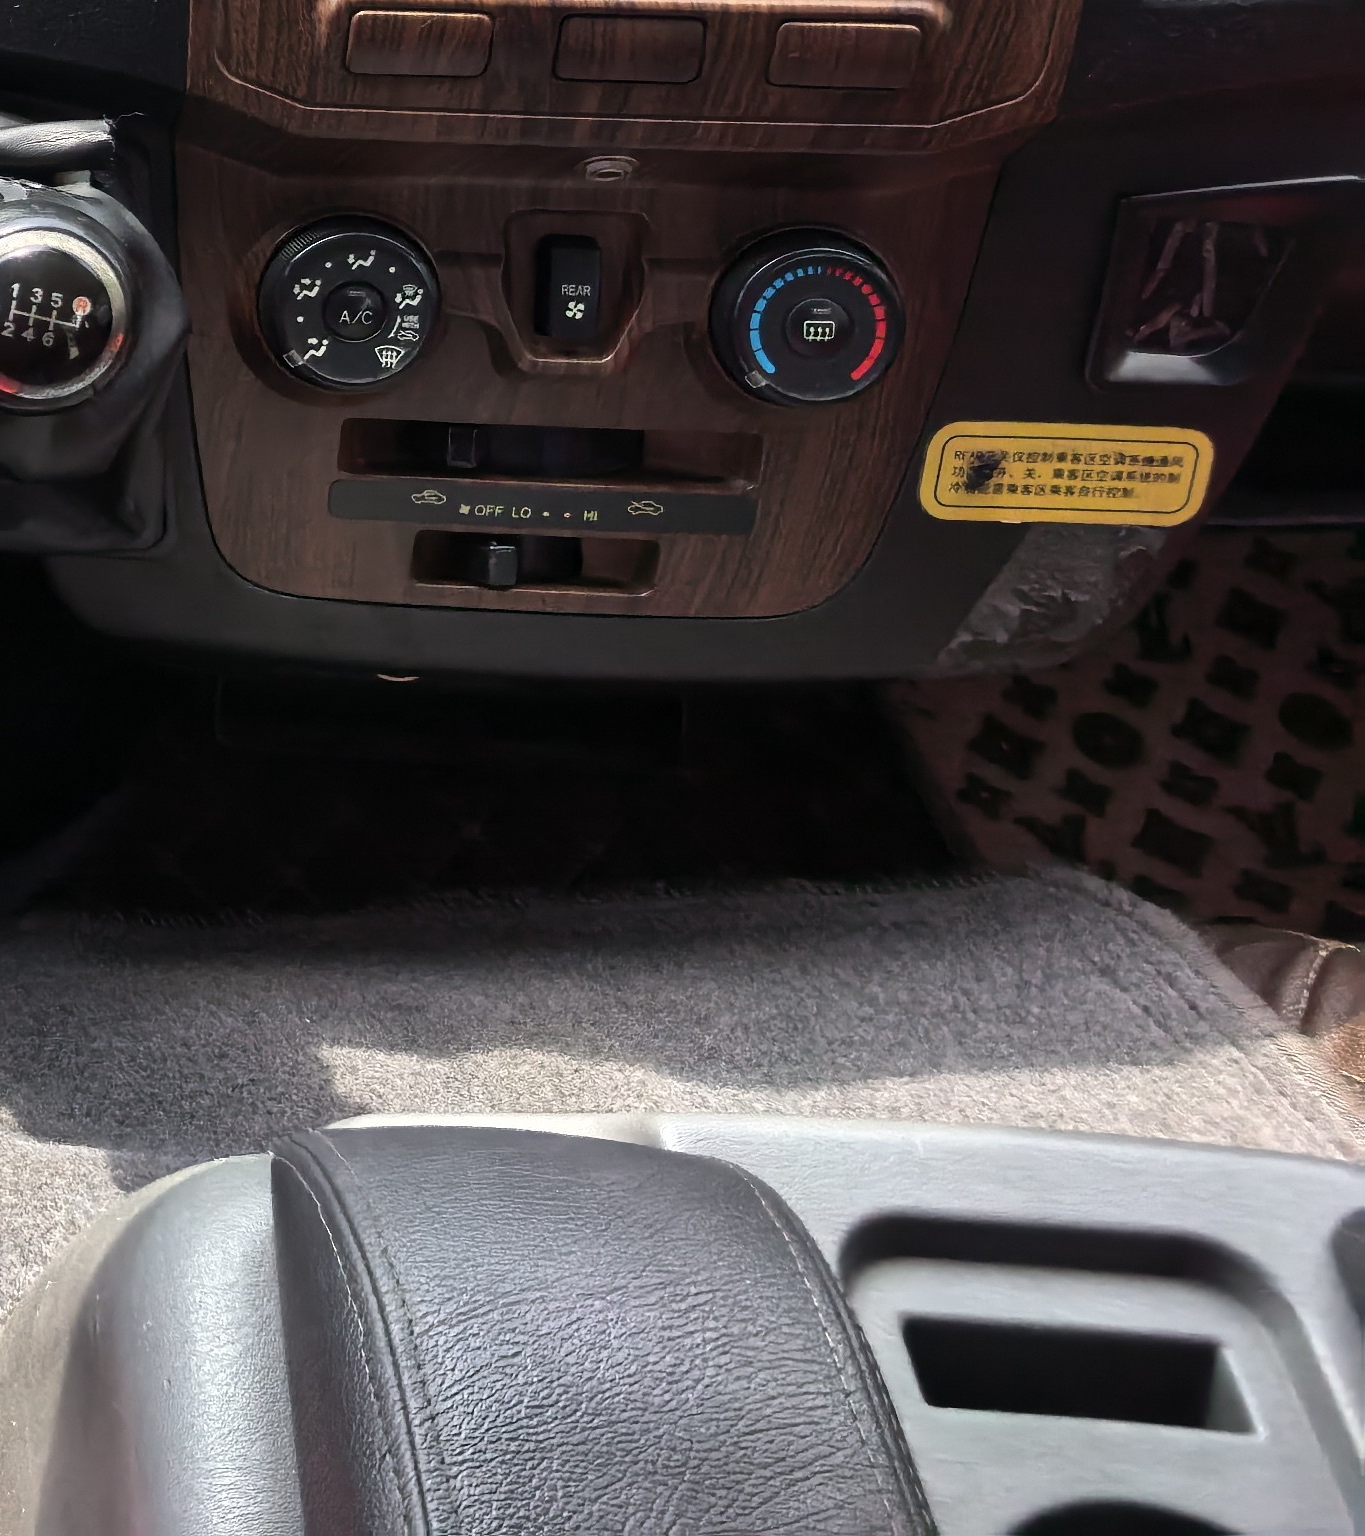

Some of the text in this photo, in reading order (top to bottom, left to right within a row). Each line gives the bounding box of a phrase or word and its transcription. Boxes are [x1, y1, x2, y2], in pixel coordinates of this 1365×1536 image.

[10, 282, 21, 298] 1
[30, 287, 43, 304] 3
[50, 292, 63, 308] 5
[561, 284, 591, 296] REAR
[339, 310, 373, 324] A/C
[0, 322, 55, 347] 2 4 6
[474, 504, 504, 517] OFF
[512, 506, 532, 519] LO
